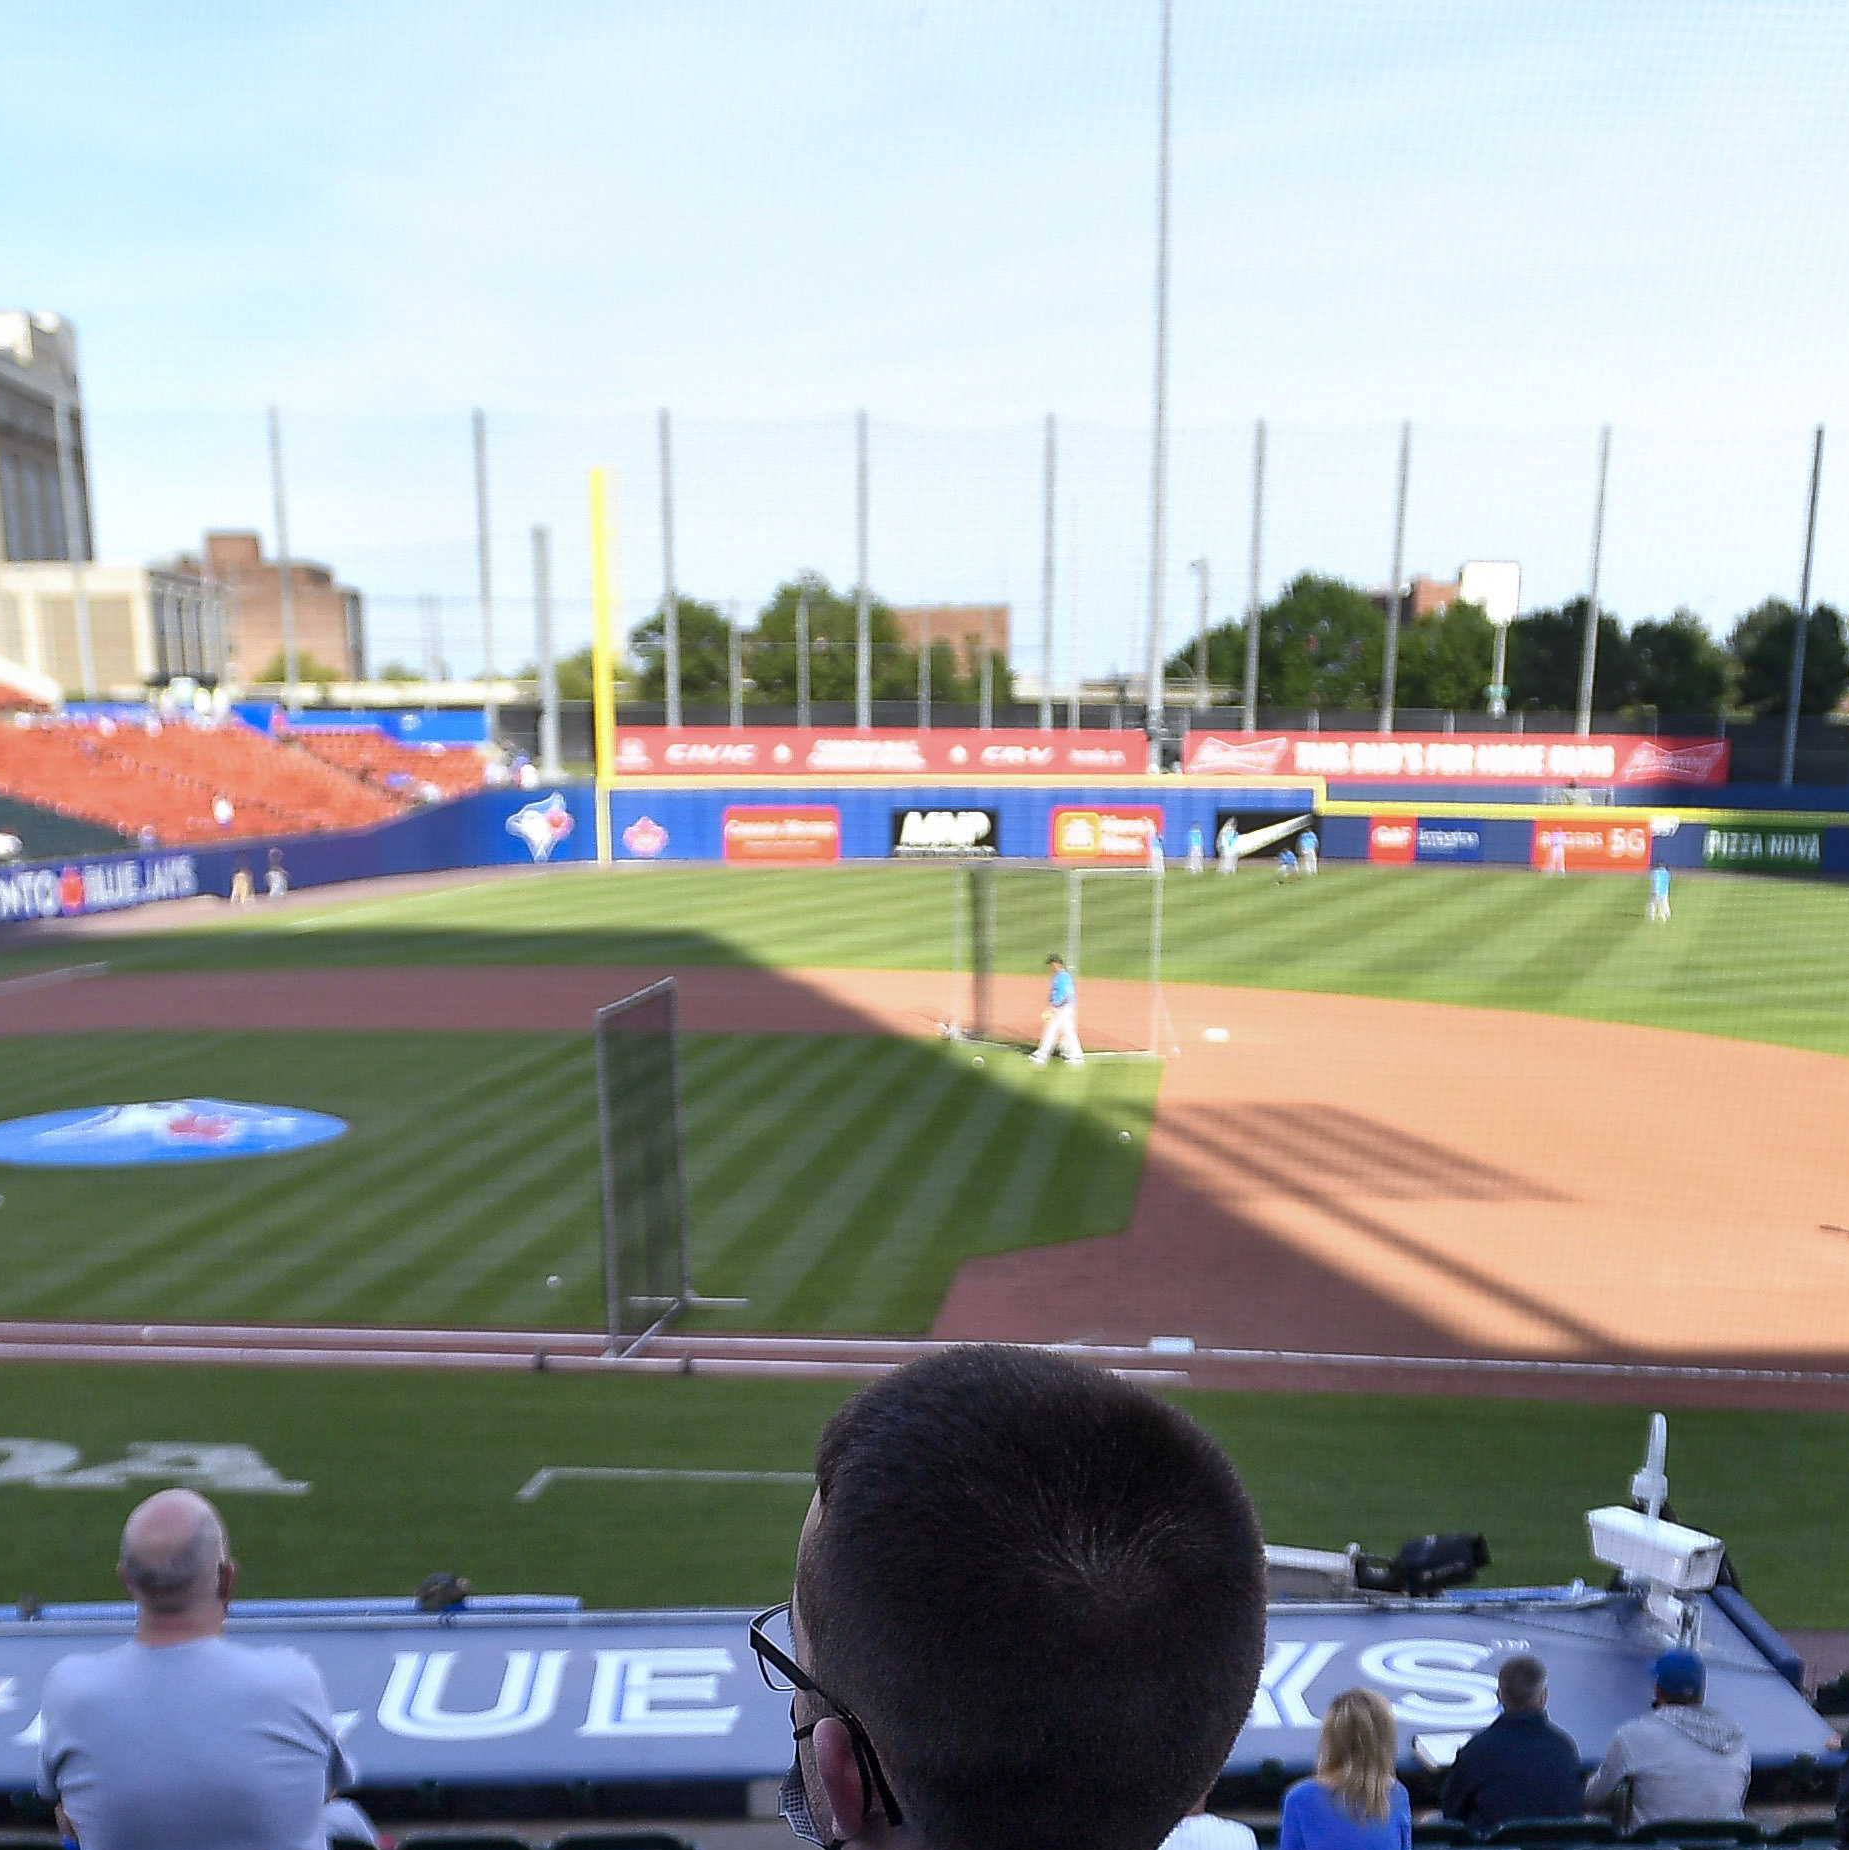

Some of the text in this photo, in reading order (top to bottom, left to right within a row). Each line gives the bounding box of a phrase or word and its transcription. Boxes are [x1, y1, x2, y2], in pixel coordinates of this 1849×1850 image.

[1539, 827, 1647, 858] RGERS 5G
[1702, 828, 1821, 862] PIZZA NOVA
